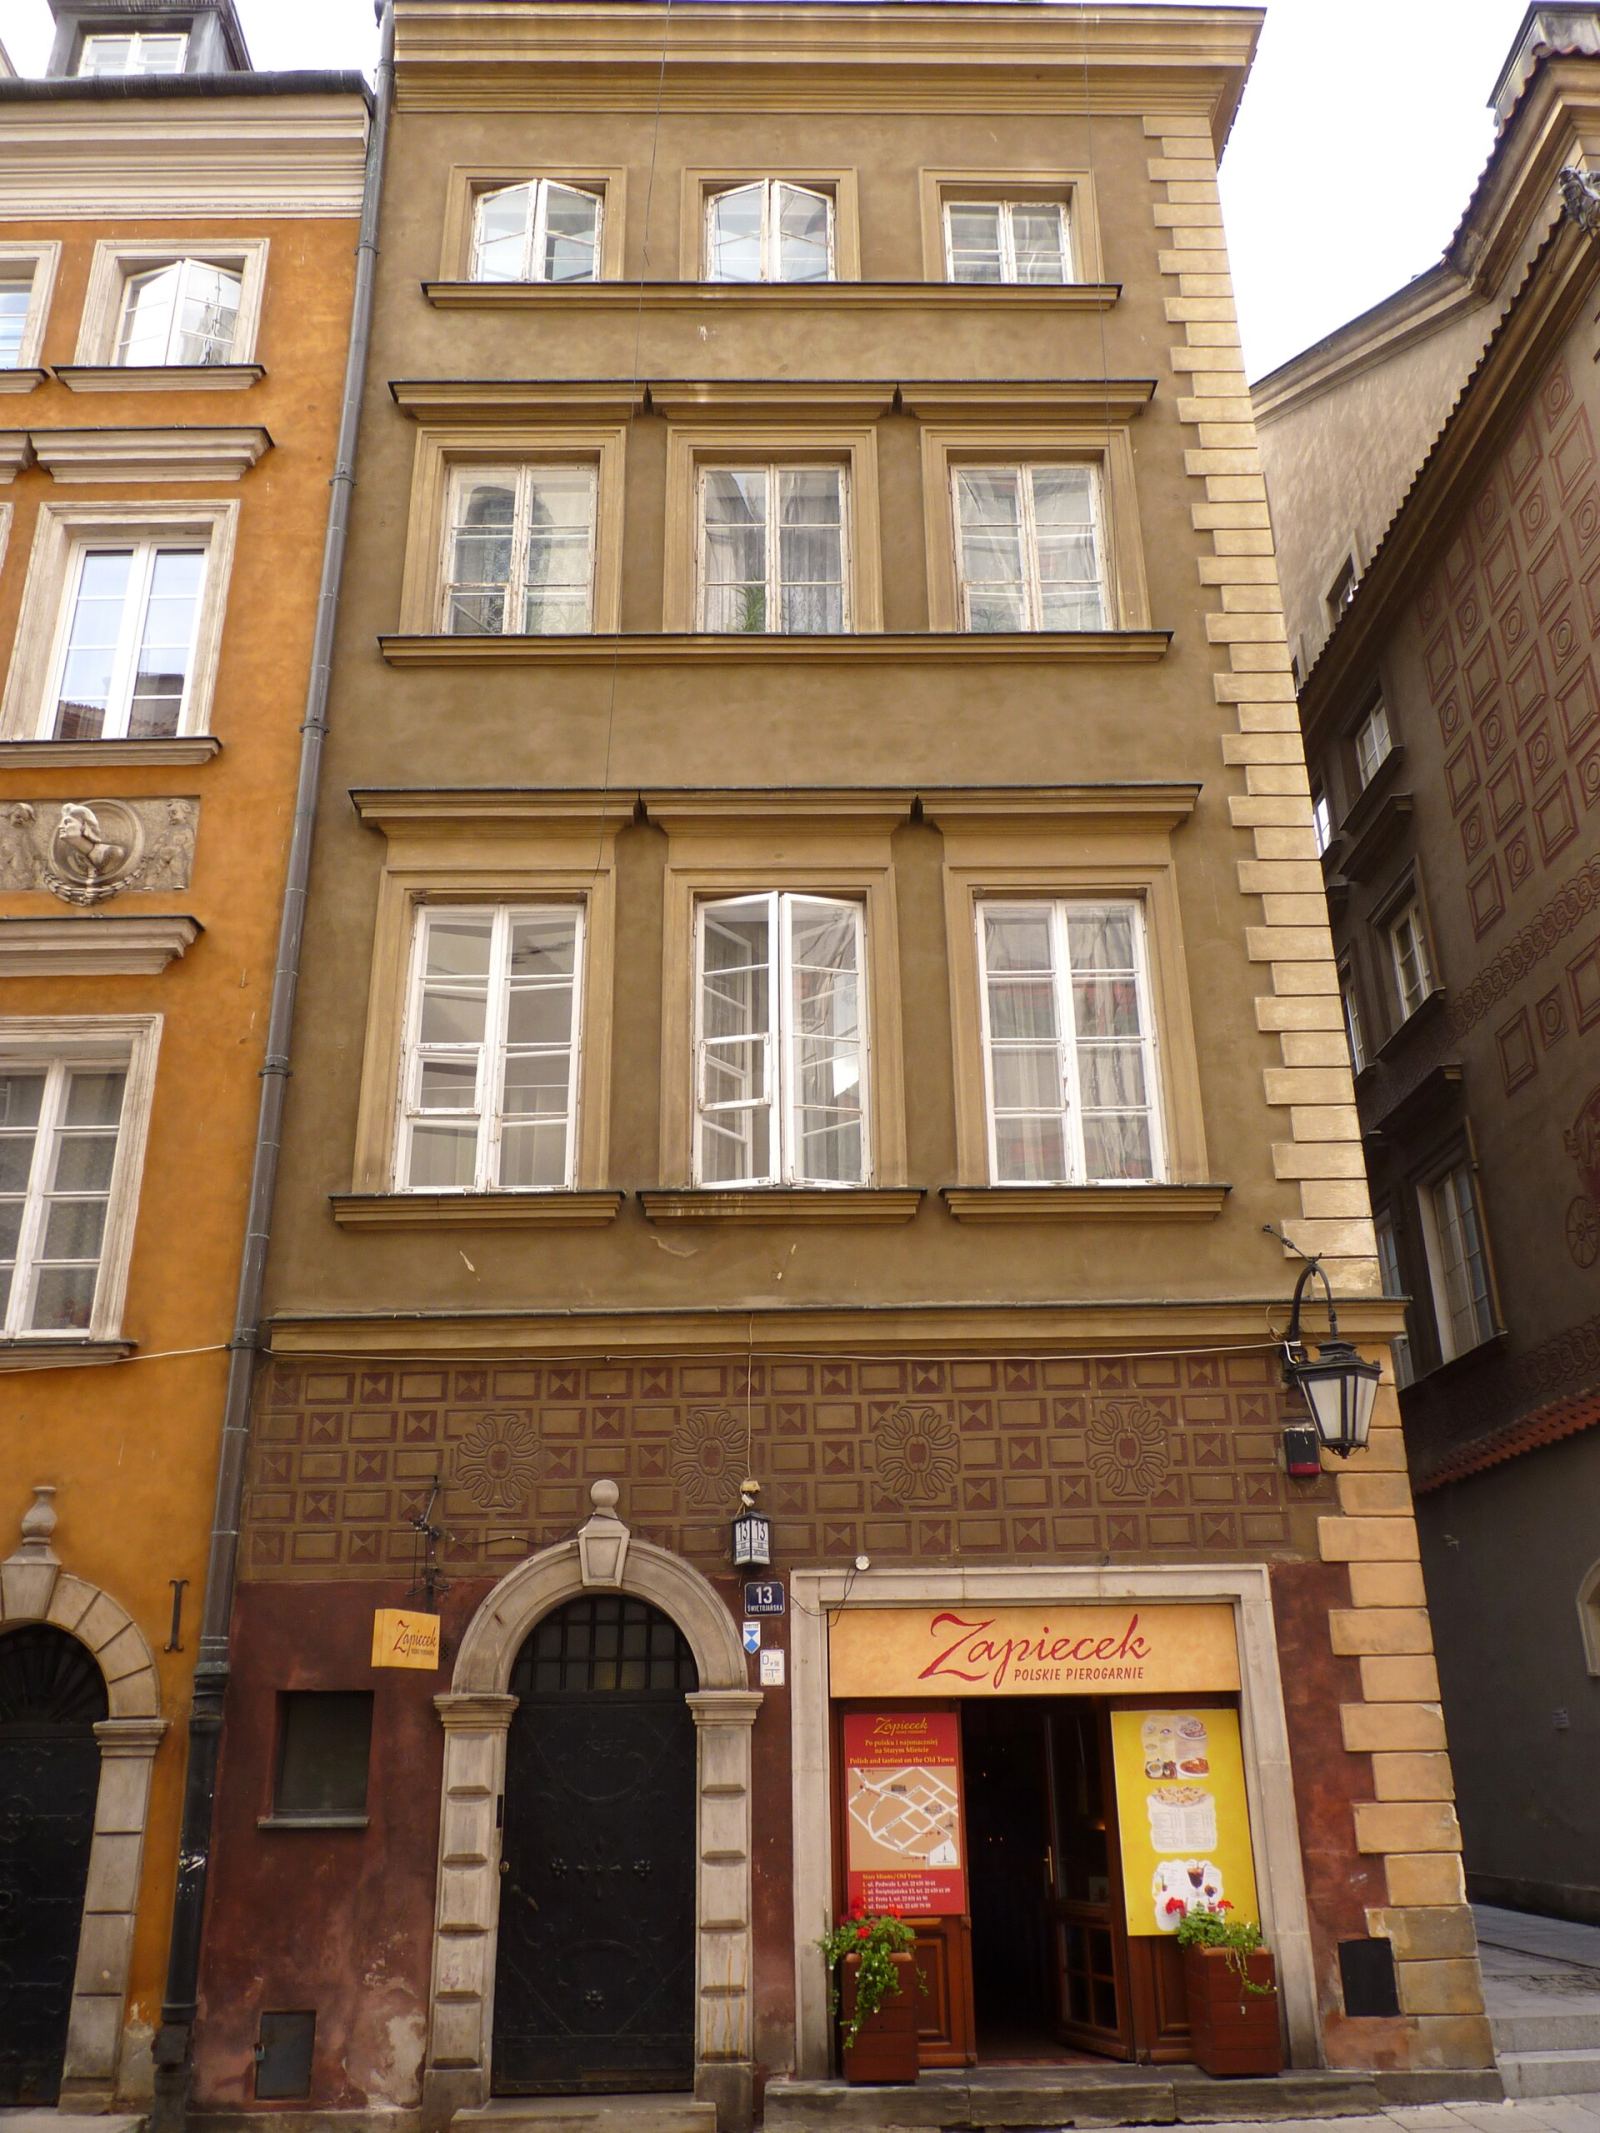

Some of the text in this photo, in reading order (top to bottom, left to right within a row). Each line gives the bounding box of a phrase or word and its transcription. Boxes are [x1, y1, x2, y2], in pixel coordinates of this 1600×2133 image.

[755, 1586, 773, 1604] 13
[393, 1619, 437, 1658] Zapiecek
[917, 1612, 1152, 1690] Zapiecek
[1014, 1667, 1144, 1682] POLSKIE PIEROGARNIE
[873, 1717, 928, 1736] Zapiecek
